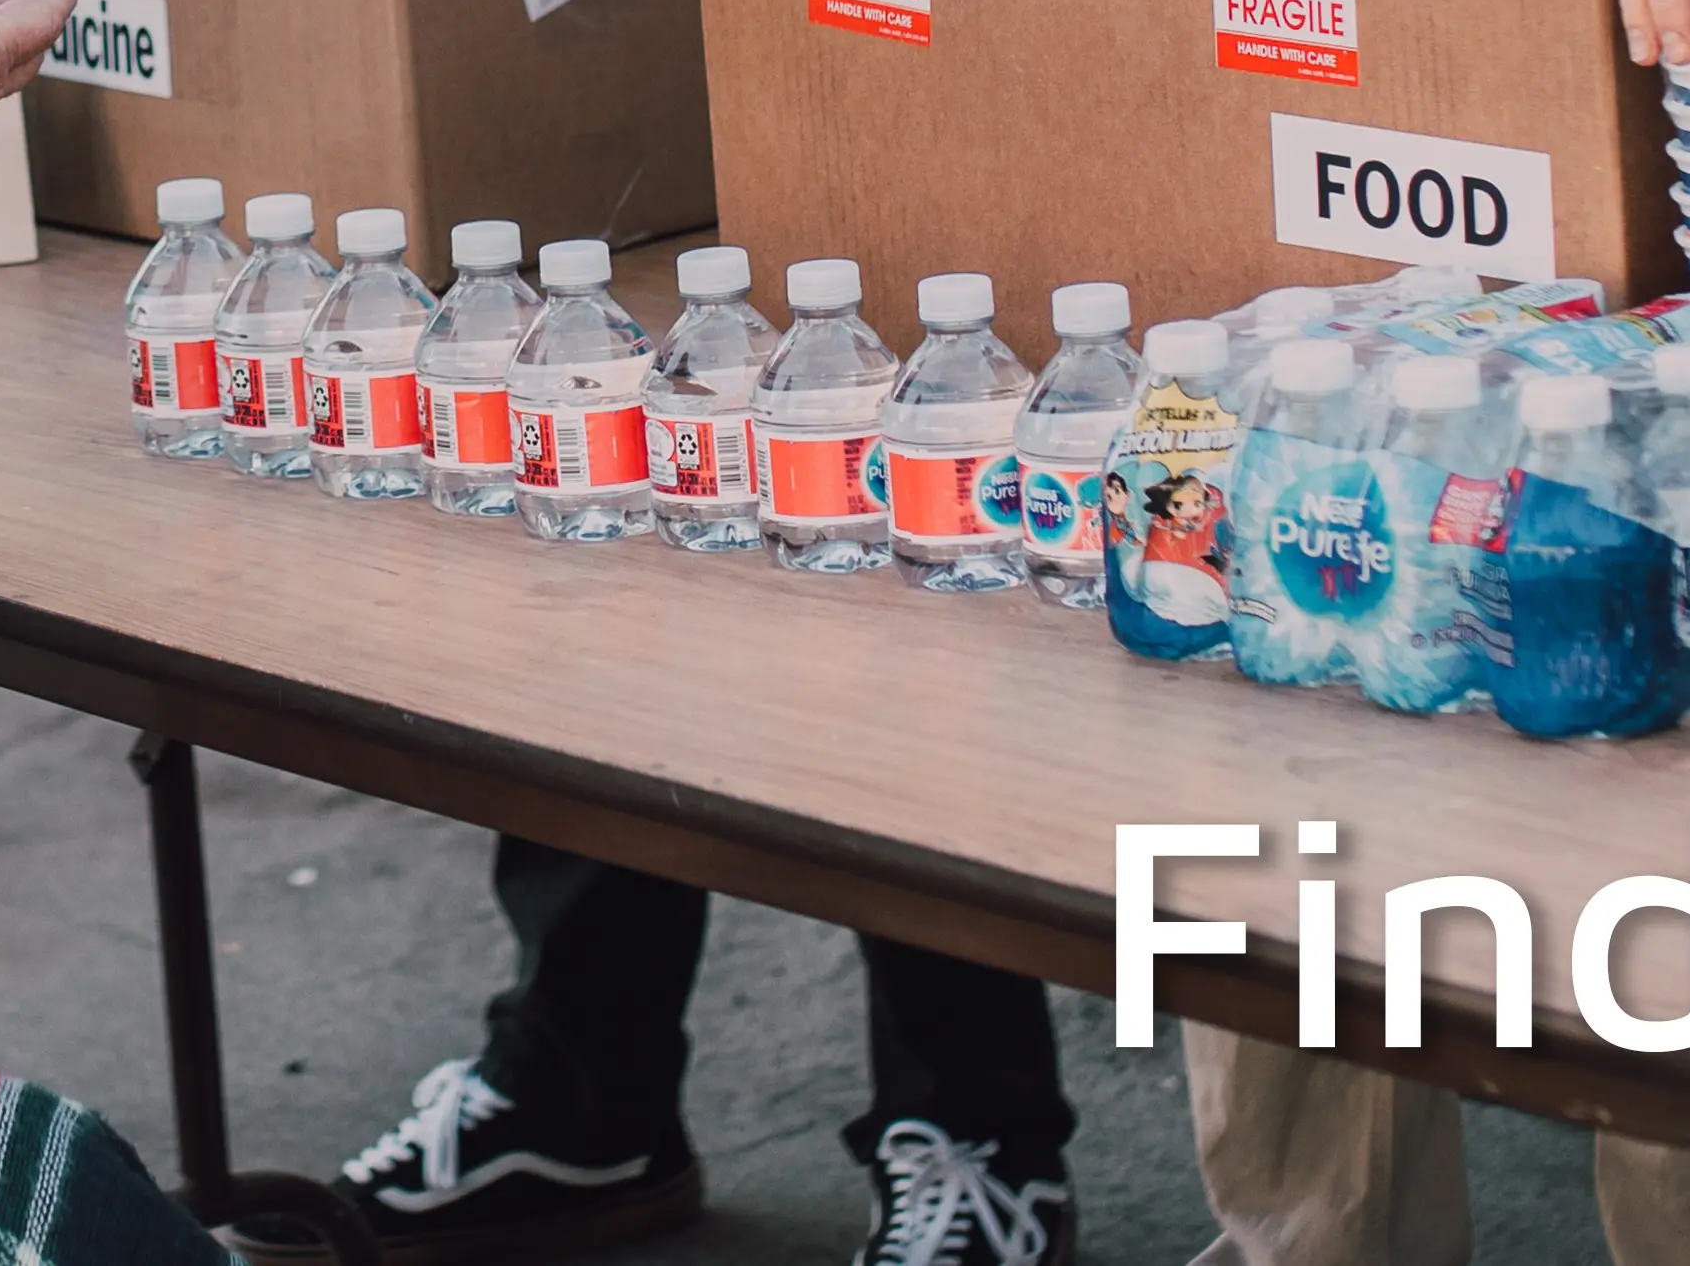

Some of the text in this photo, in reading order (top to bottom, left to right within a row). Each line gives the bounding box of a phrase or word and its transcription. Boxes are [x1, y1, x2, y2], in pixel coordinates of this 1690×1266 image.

[826, 0, 913, 29] HANDLE WITH CARE
[1237, 41, 1337, 68] HANDLE WITH CARE
[1315, 150, 1509, 248] FOOD
[980, 484, 1018, 502] Pure
